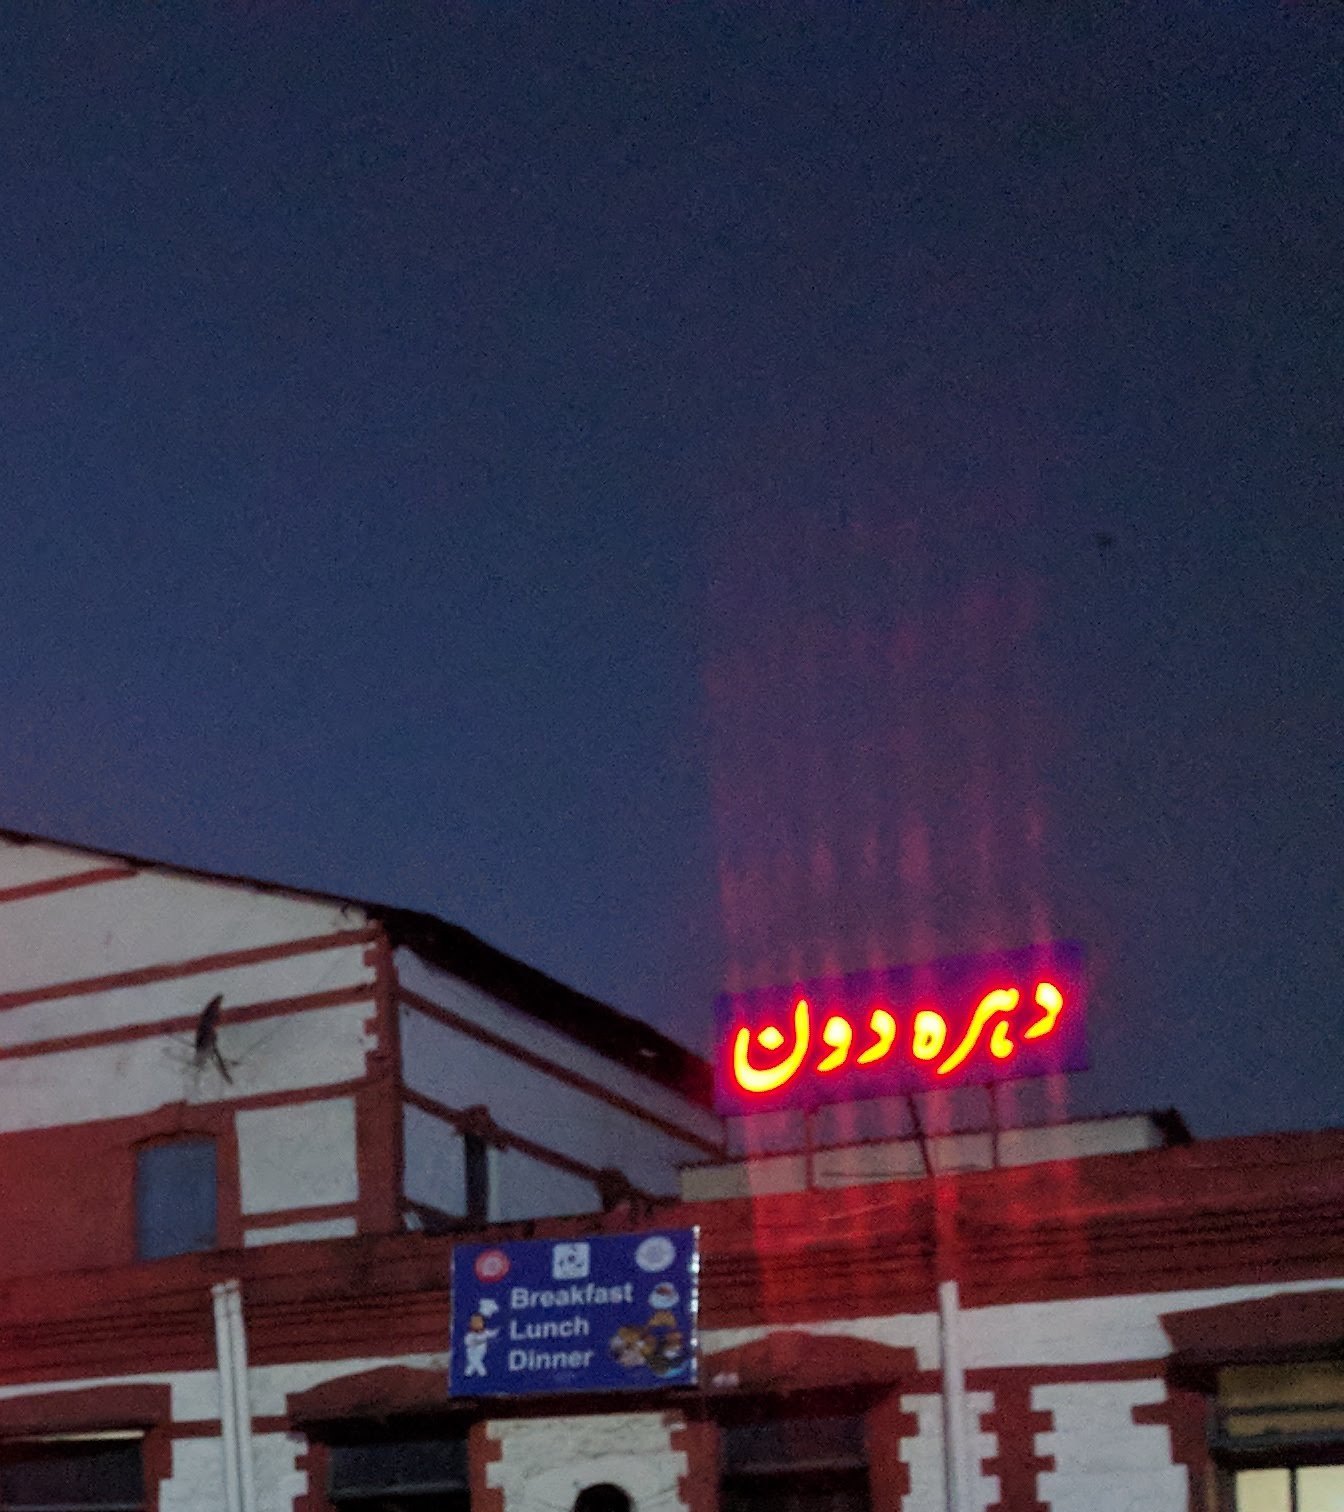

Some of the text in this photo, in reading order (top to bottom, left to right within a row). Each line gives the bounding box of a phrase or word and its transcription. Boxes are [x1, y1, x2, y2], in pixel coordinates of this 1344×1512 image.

[511, 1281, 635, 1310] Breakfast
[509, 1315, 591, 1341] Lunch
[506, 1348, 594, 1373] Dinner
